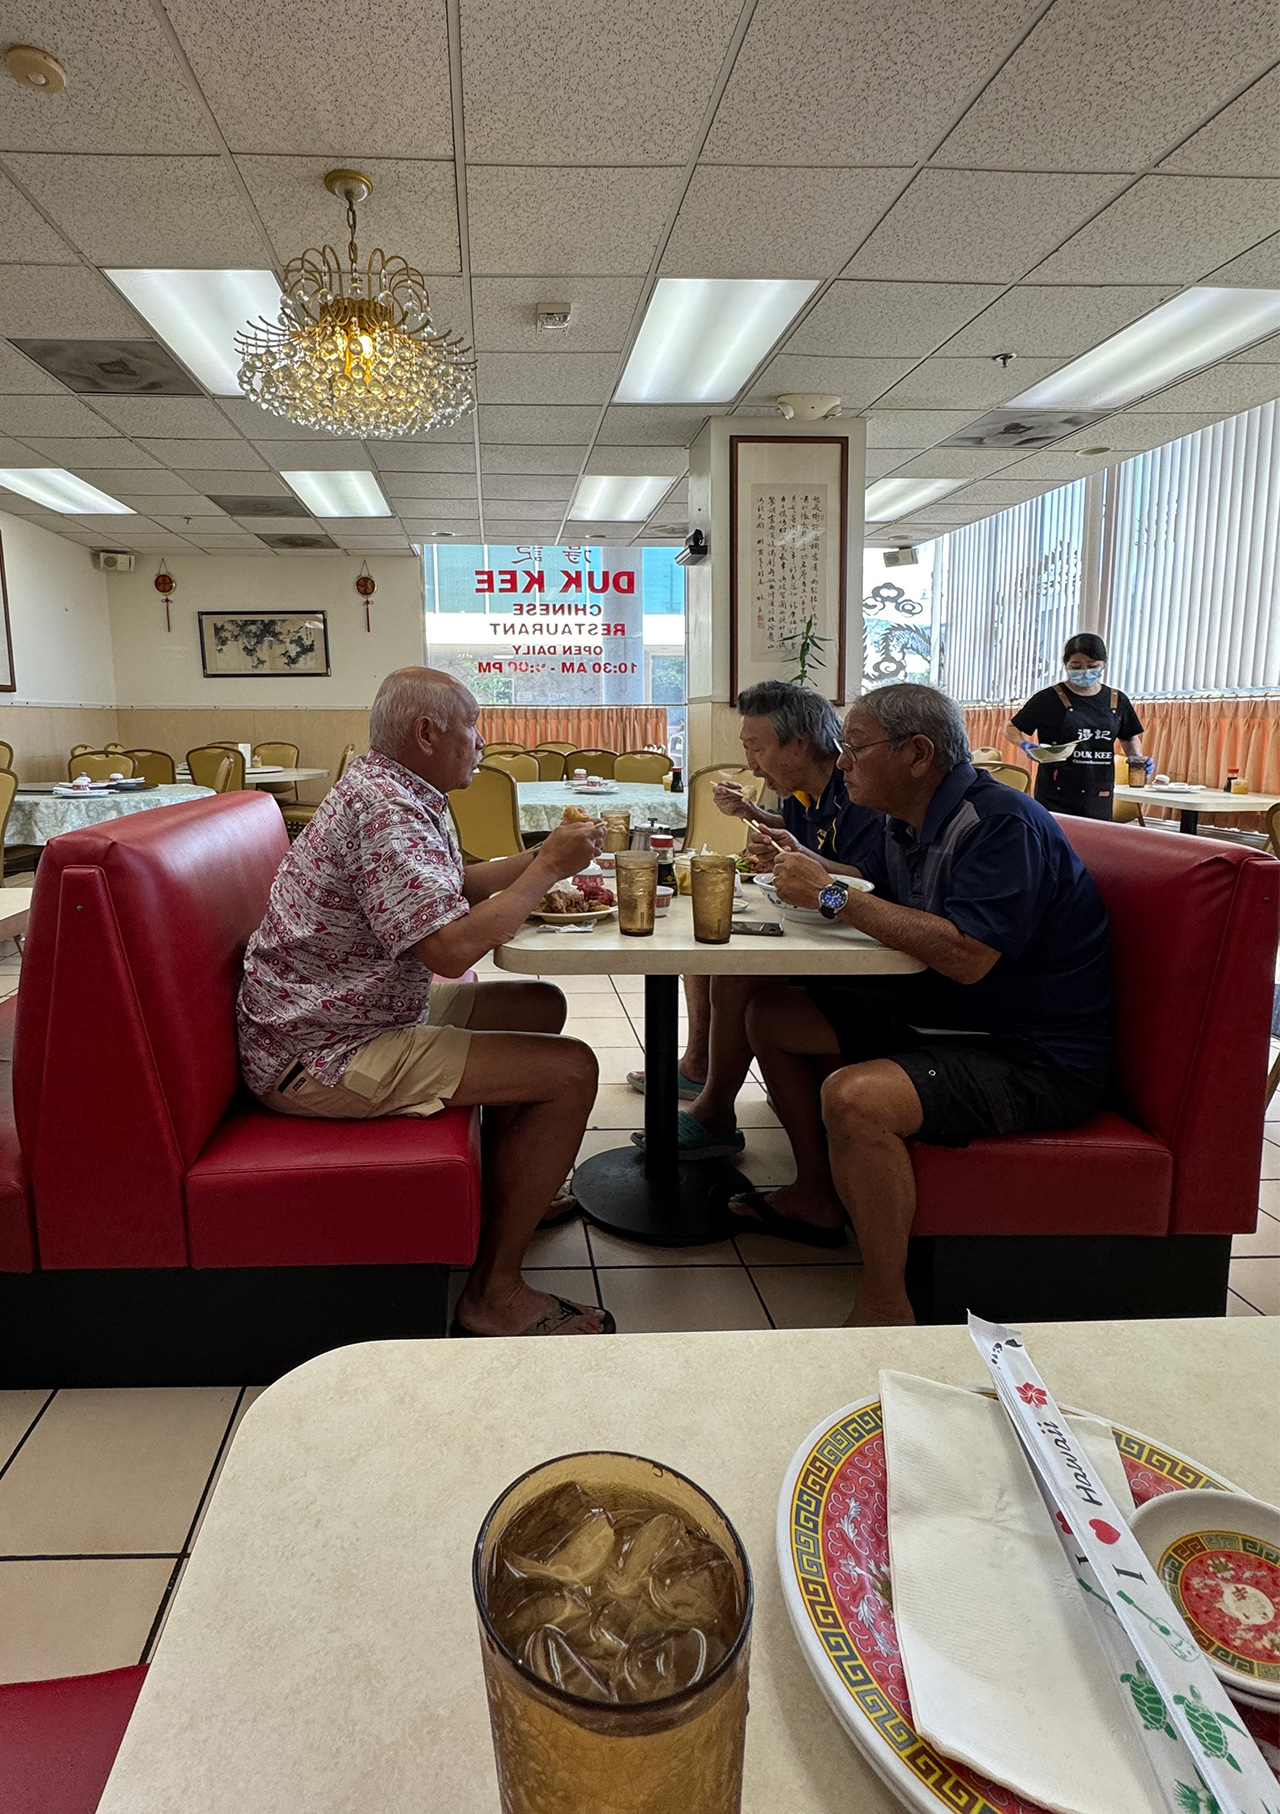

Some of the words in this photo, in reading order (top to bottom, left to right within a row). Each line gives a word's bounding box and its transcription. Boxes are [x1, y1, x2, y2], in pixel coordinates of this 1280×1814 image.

[1073, 750, 1093, 759] DUK
[1095, 751, 1112, 759] KEE
[1036, 1420, 1103, 1507] Hawaii
